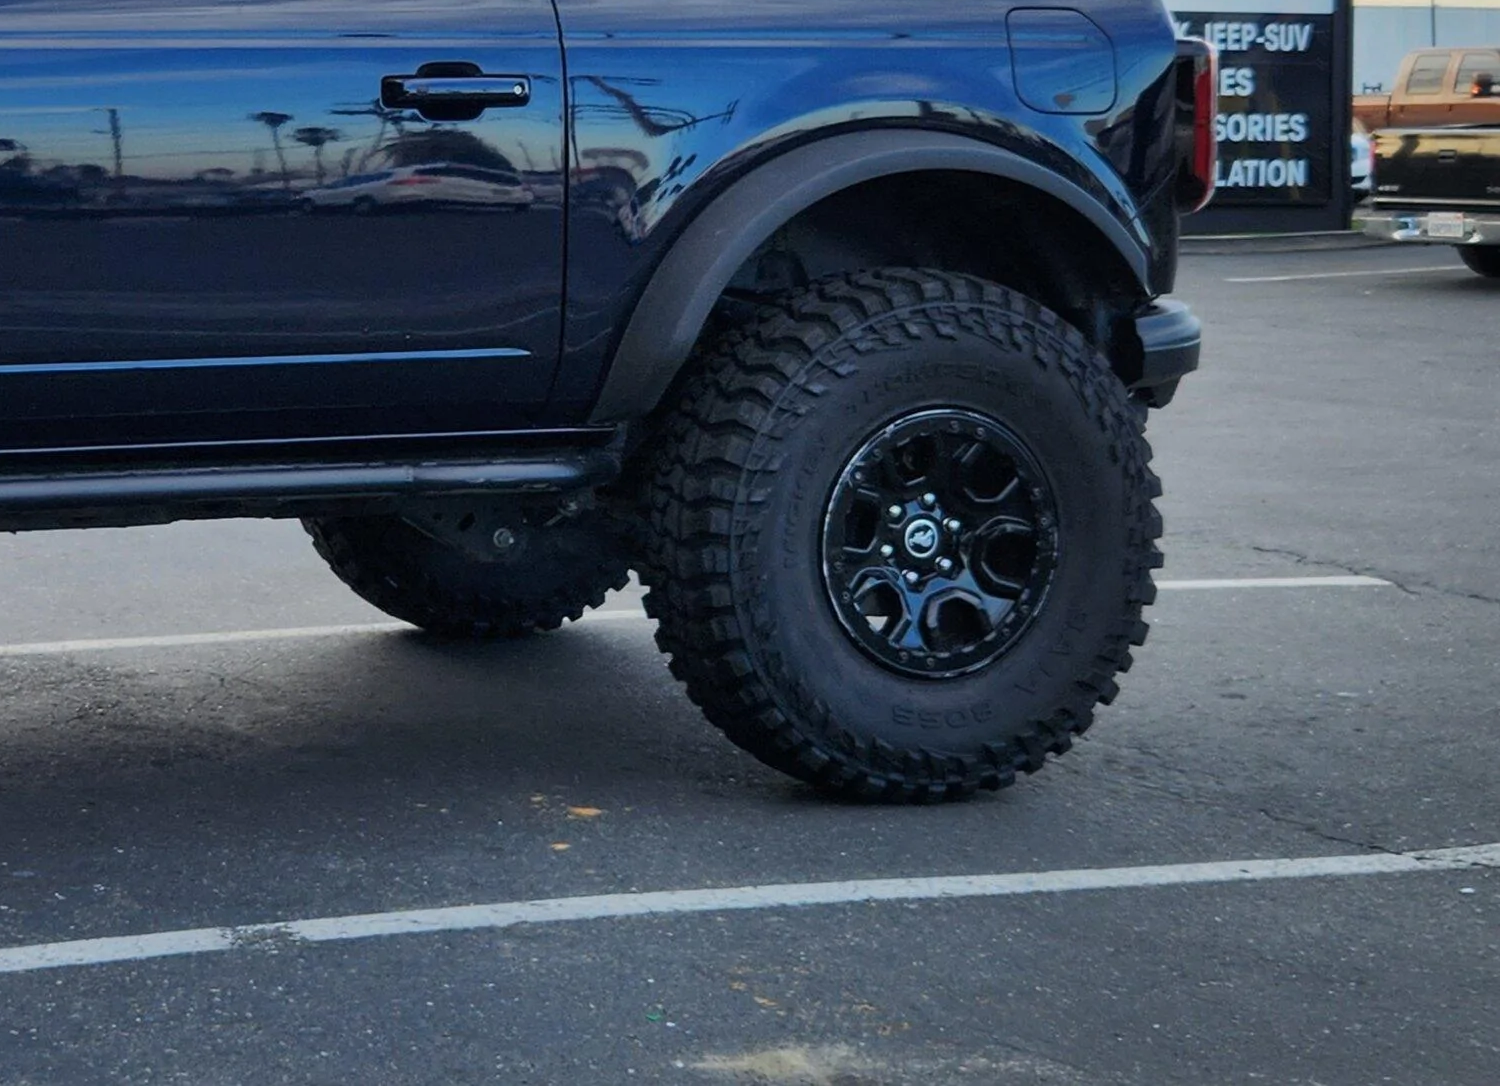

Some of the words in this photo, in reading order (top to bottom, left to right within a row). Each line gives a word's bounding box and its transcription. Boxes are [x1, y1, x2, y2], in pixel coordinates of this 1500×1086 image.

[1217, 67, 1255, 97] ES
[1213, 114, 1308, 142] SORIES
[1214, 160, 1306, 187] LATION
